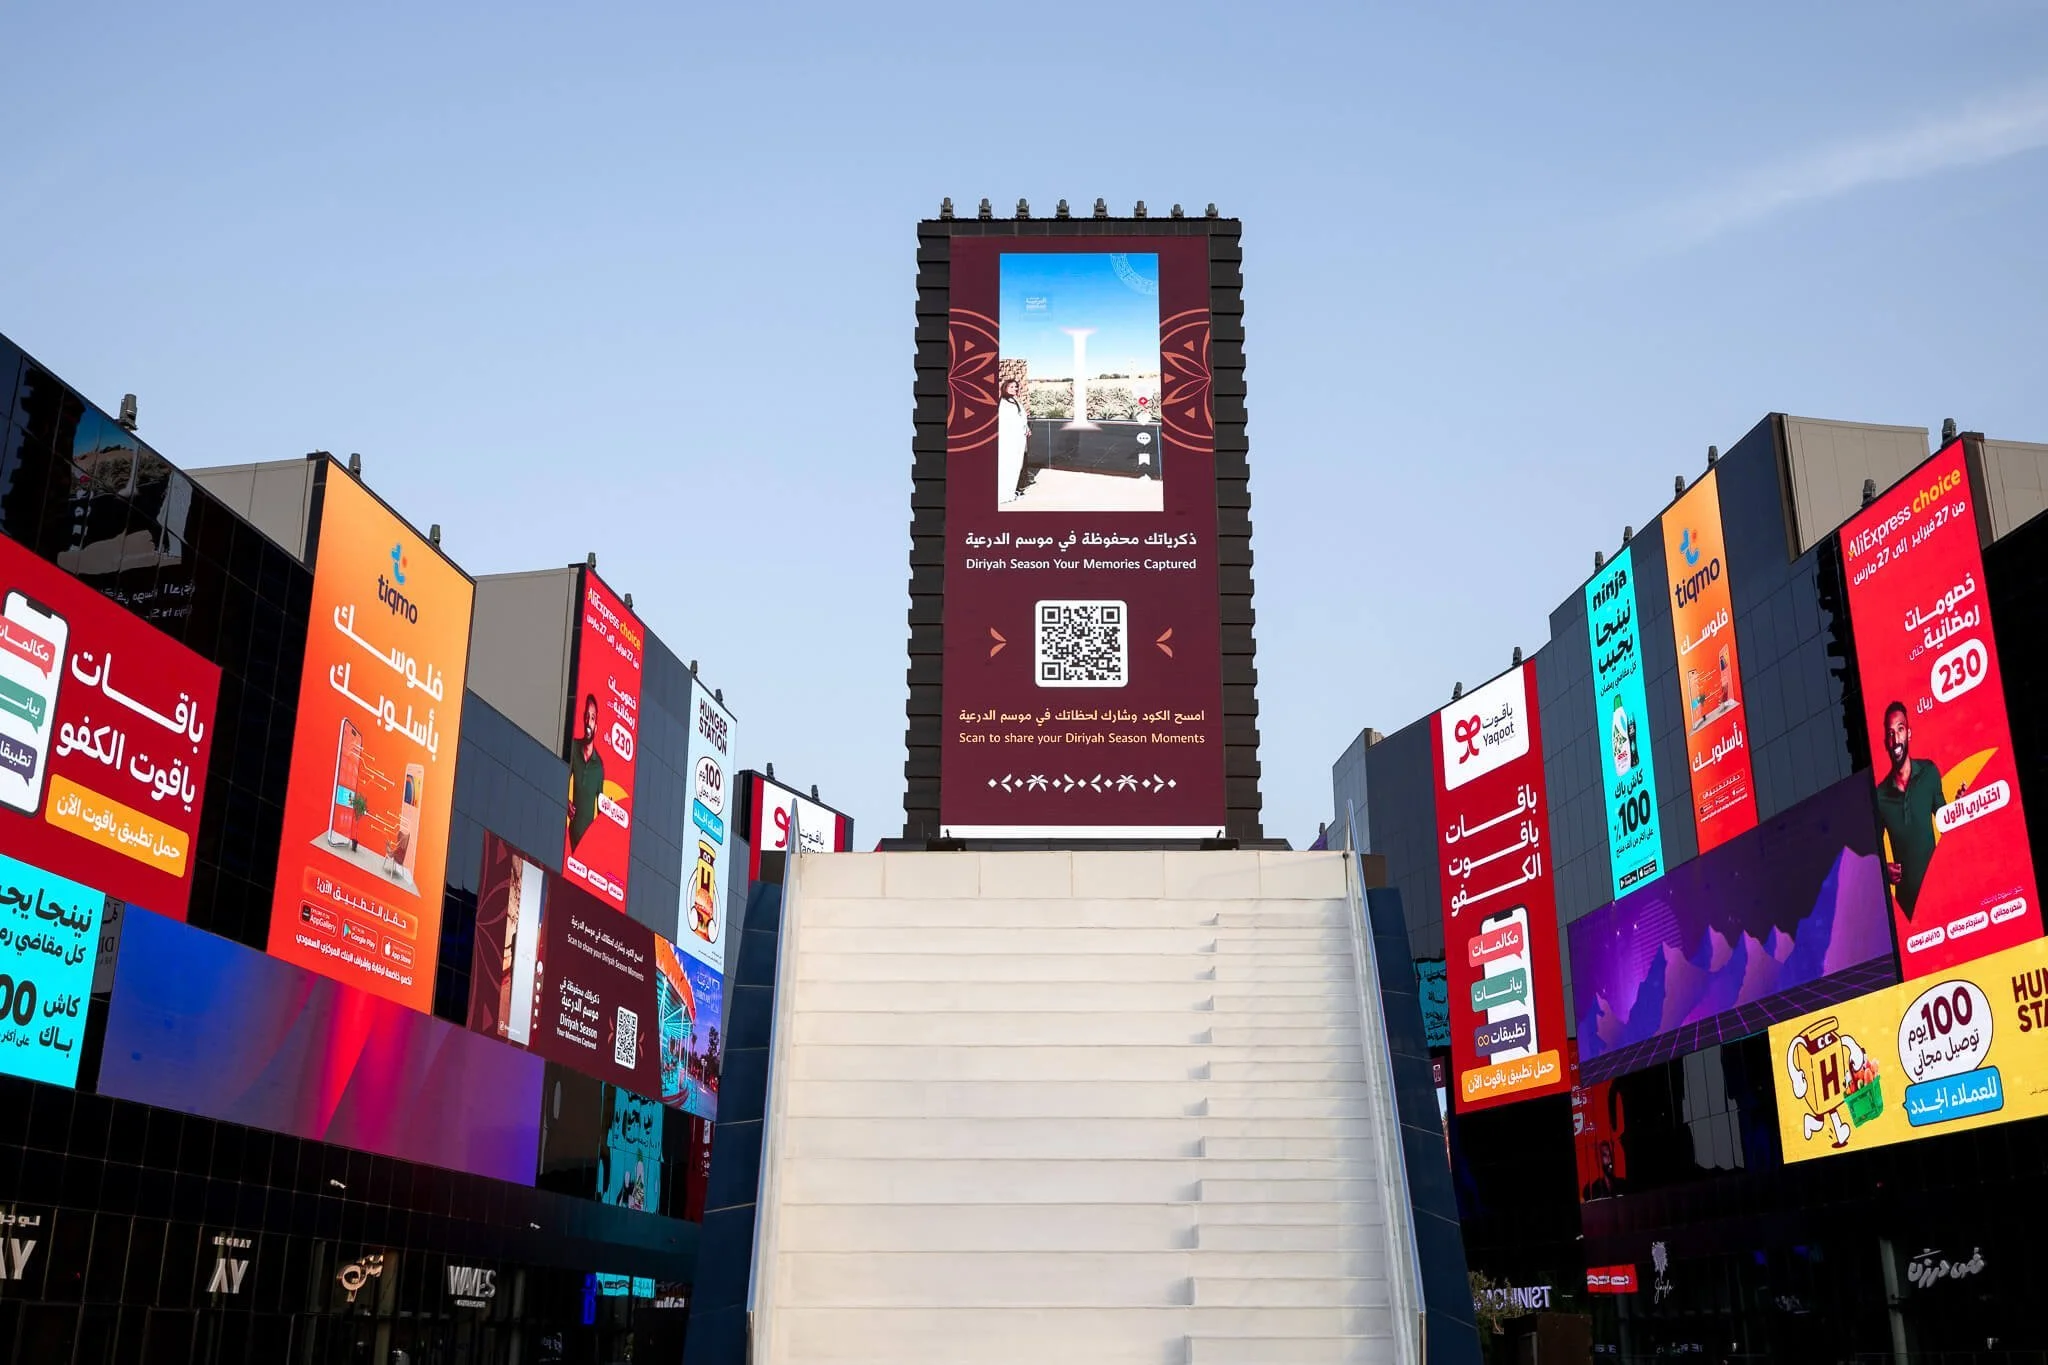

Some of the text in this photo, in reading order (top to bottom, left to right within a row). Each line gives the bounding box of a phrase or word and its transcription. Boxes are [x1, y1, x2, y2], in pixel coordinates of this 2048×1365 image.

[1848, 469, 1961, 560] AliExpress choice
[1935, 506, 1949, 527] 27
[1951, 501, 1966, 518] من
[965, 530, 1197, 551] ذكرياتك محفوظة في موسم الدرعية
[1911, 520, 1936, 548] فبراير
[966, 558, 1197, 571] Diriyah Season Your Memories Captured
[1854, 563, 1877, 585] مارس
[1877, 548, 1890, 569] 27
[378, 574, 418, 624] tiqmo
[1592, 567, 1627, 612] ninja
[1674, 557, 1720, 609] tiqmo
[1904, 572, 1976, 632] خصومات
[587, 587, 641, 651] AliExpress choice
[1595, 599, 1631, 648] نينجا
[1680, 608, 1729, 656] فلوسك
[1924, 605, 1981, 649] رمضانية
[334, 604, 443, 701] فلوسك
[1598, 631, 1634, 677] يجيب
[1938, 648, 1981, 694] 230
[71, 651, 204, 754] باقات
[330, 663, 439, 761] بأسلوبك
[699, 697, 728, 738] HUNGER
[959, 708, 1205, 726] امسح الكود وشارك لحظاتك في موسم الدرعية
[1481, 702, 1513, 729] ياقوت
[614, 729, 631, 753] 230
[699, 716, 727, 756] STATION
[959, 733, 1205, 746] Scan to share your Diriyah Season Moments
[1482, 721, 1515, 747] Yaqoot
[1692, 725, 1743, 774] بأسلوبك
[56, 715, 196, 812] ياقوت الكفو
[705, 763, 721, 791] 100
[1614, 768, 1644, 800] كاش باك
[1445, 784, 1537, 844] باقات
[1943, 786, 2000, 825] اختياري الأول
[82, 809, 117, 838] ياقوت
[118, 821, 152, 850] تطبيق
[153, 834, 181, 859] حمل
[1448, 820, 1539, 879] ياقوت
[1450, 852, 1542, 917] الكفو
[35, 888, 93, 938] نينجا
[310, 915, 336, 933] AppGallery
[15, 932, 88, 966] كل مقاضي
[351, 933, 366, 945] Google
[1472, 930, 1519, 957] مكالمات
[567, 934, 578, 947] Scan
[582, 941, 593, 956] share
[593, 949, 602, 963] your
[602, 951, 615, 967] Diriyah
[615, 959, 627, 973] Season
[627, 965, 644, 982] Moments
[43, 994, 80, 1018] كاش
[561, 991, 599, 1020] موسم الدرعية
[1474, 979, 1523, 1003] بيانات
[559, 1013, 598, 1039] Diriyah Season
[1921, 986, 1973, 1041] 100
[39, 1025, 73, 1058] باك
[1491, 1023, 1526, 1045] تطبيقات
[1908, 1024, 1927, 1050] يوم
[1534, 1062, 1555, 1080] حمل
[1913, 1030, 1980, 1080] توصيل مجاني
[1484, 1072, 1506, 1090] ياقوت
[1508, 1068, 1533, 1087] تطبيق
[1910, 1076, 1998, 1115] للعملاء الجدد
[214, 1236, 252, 1249] LE GRAY
[449, 1265, 496, 1298] WAVES
